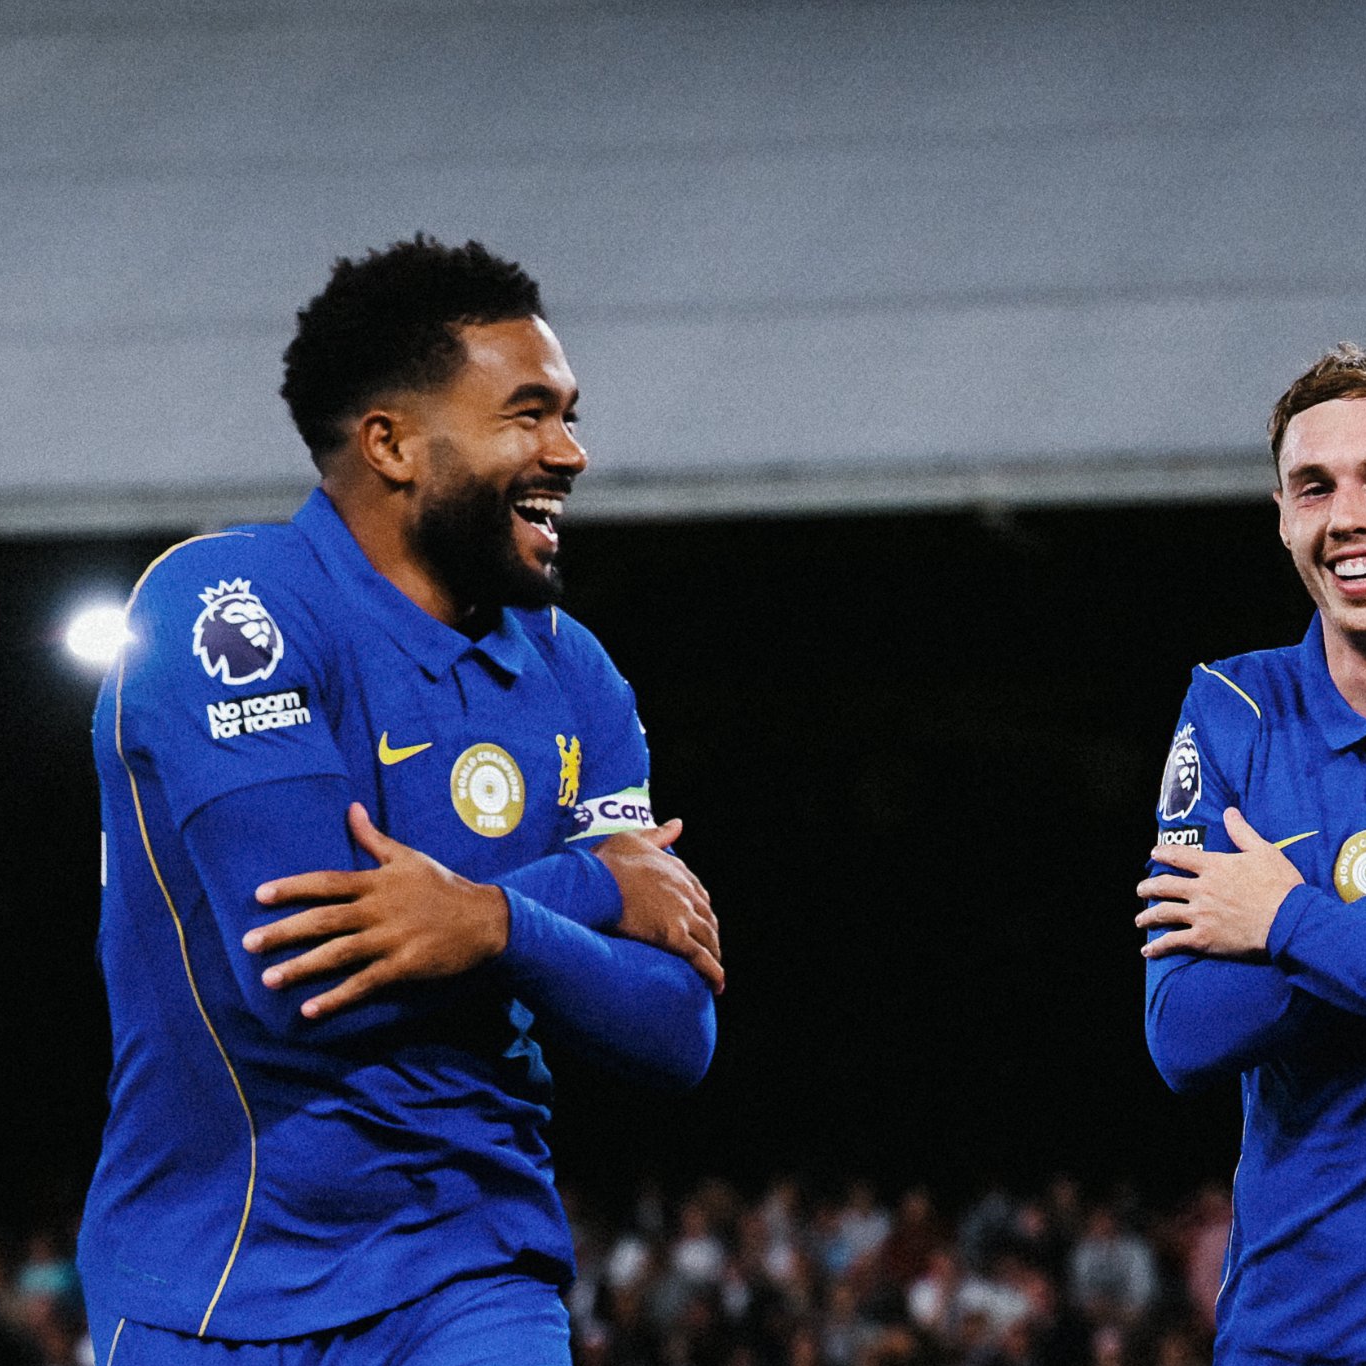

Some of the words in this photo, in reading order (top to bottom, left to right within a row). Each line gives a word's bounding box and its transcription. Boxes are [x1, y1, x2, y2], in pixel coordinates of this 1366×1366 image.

[207, 701, 241, 721] No
[242, 692, 301, 716] room
[211, 719, 243, 739] for
[244, 707, 312, 733] racism
[1339, 845, 1358, 886] WORLD
